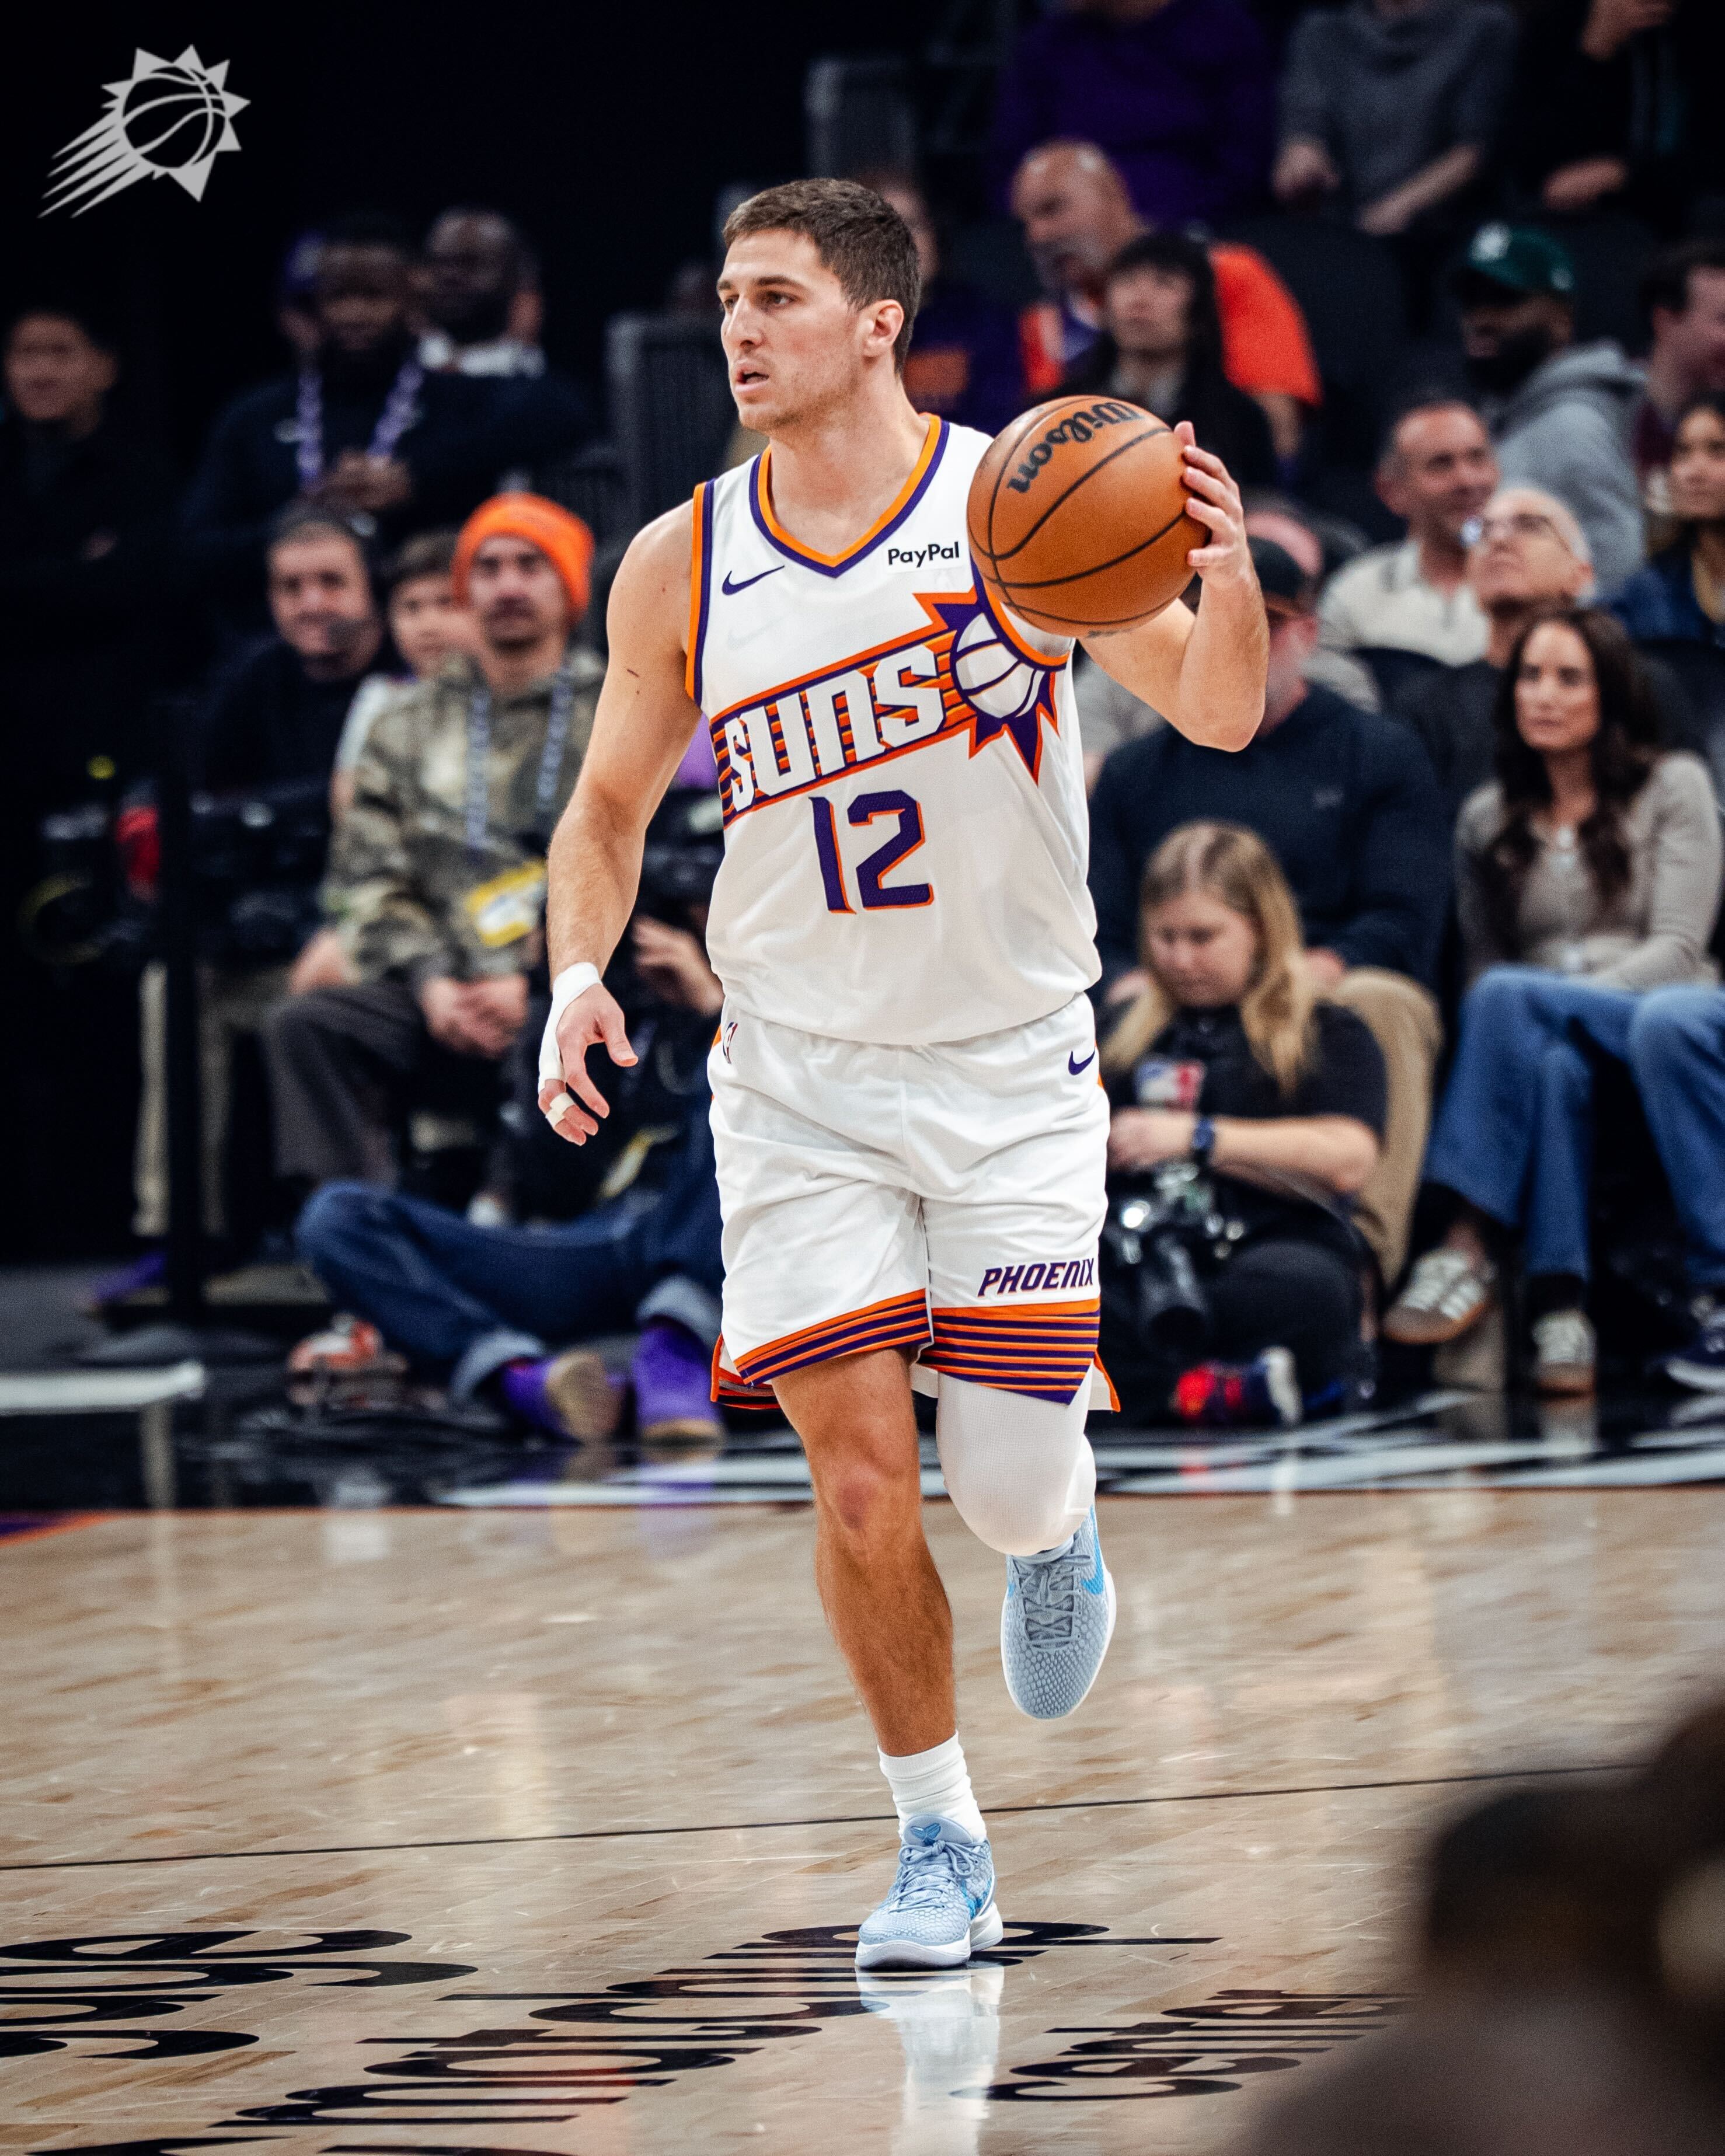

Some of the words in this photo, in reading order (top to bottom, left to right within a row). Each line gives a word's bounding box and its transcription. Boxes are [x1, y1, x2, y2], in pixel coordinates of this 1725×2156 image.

[1006, 402, 1144, 493] Wilson
[888, 540, 960, 568] PayPal
[724, 644, 944, 812] SUNS
[808, 790, 935, 915] 12
[977, 1257, 1095, 1298] PHOENIX
[949, 1989, 1420, 2101] center
